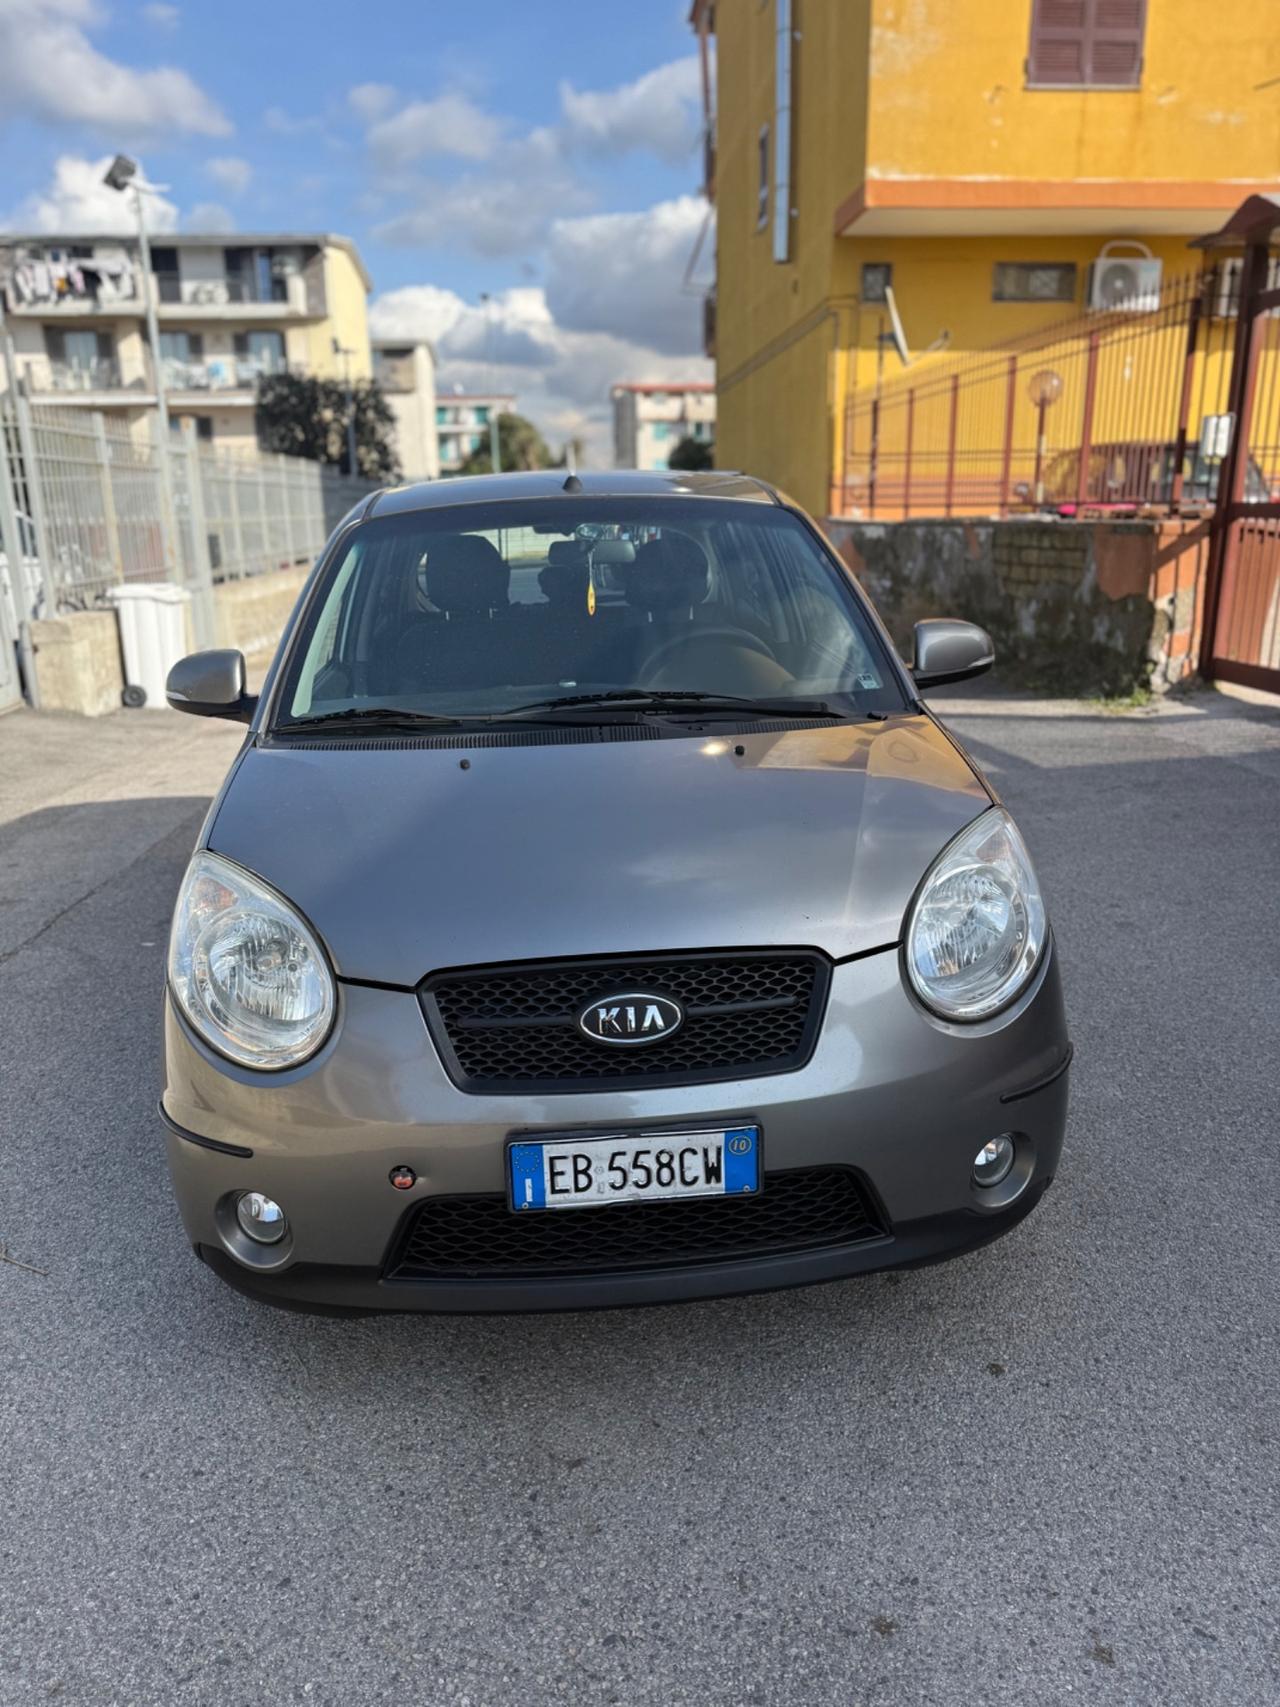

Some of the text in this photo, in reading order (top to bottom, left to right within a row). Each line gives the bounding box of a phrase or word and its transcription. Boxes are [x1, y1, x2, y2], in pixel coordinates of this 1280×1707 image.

[597, 1004, 665, 1034] KIA
[548, 1145, 722, 1194] EB 558CW
